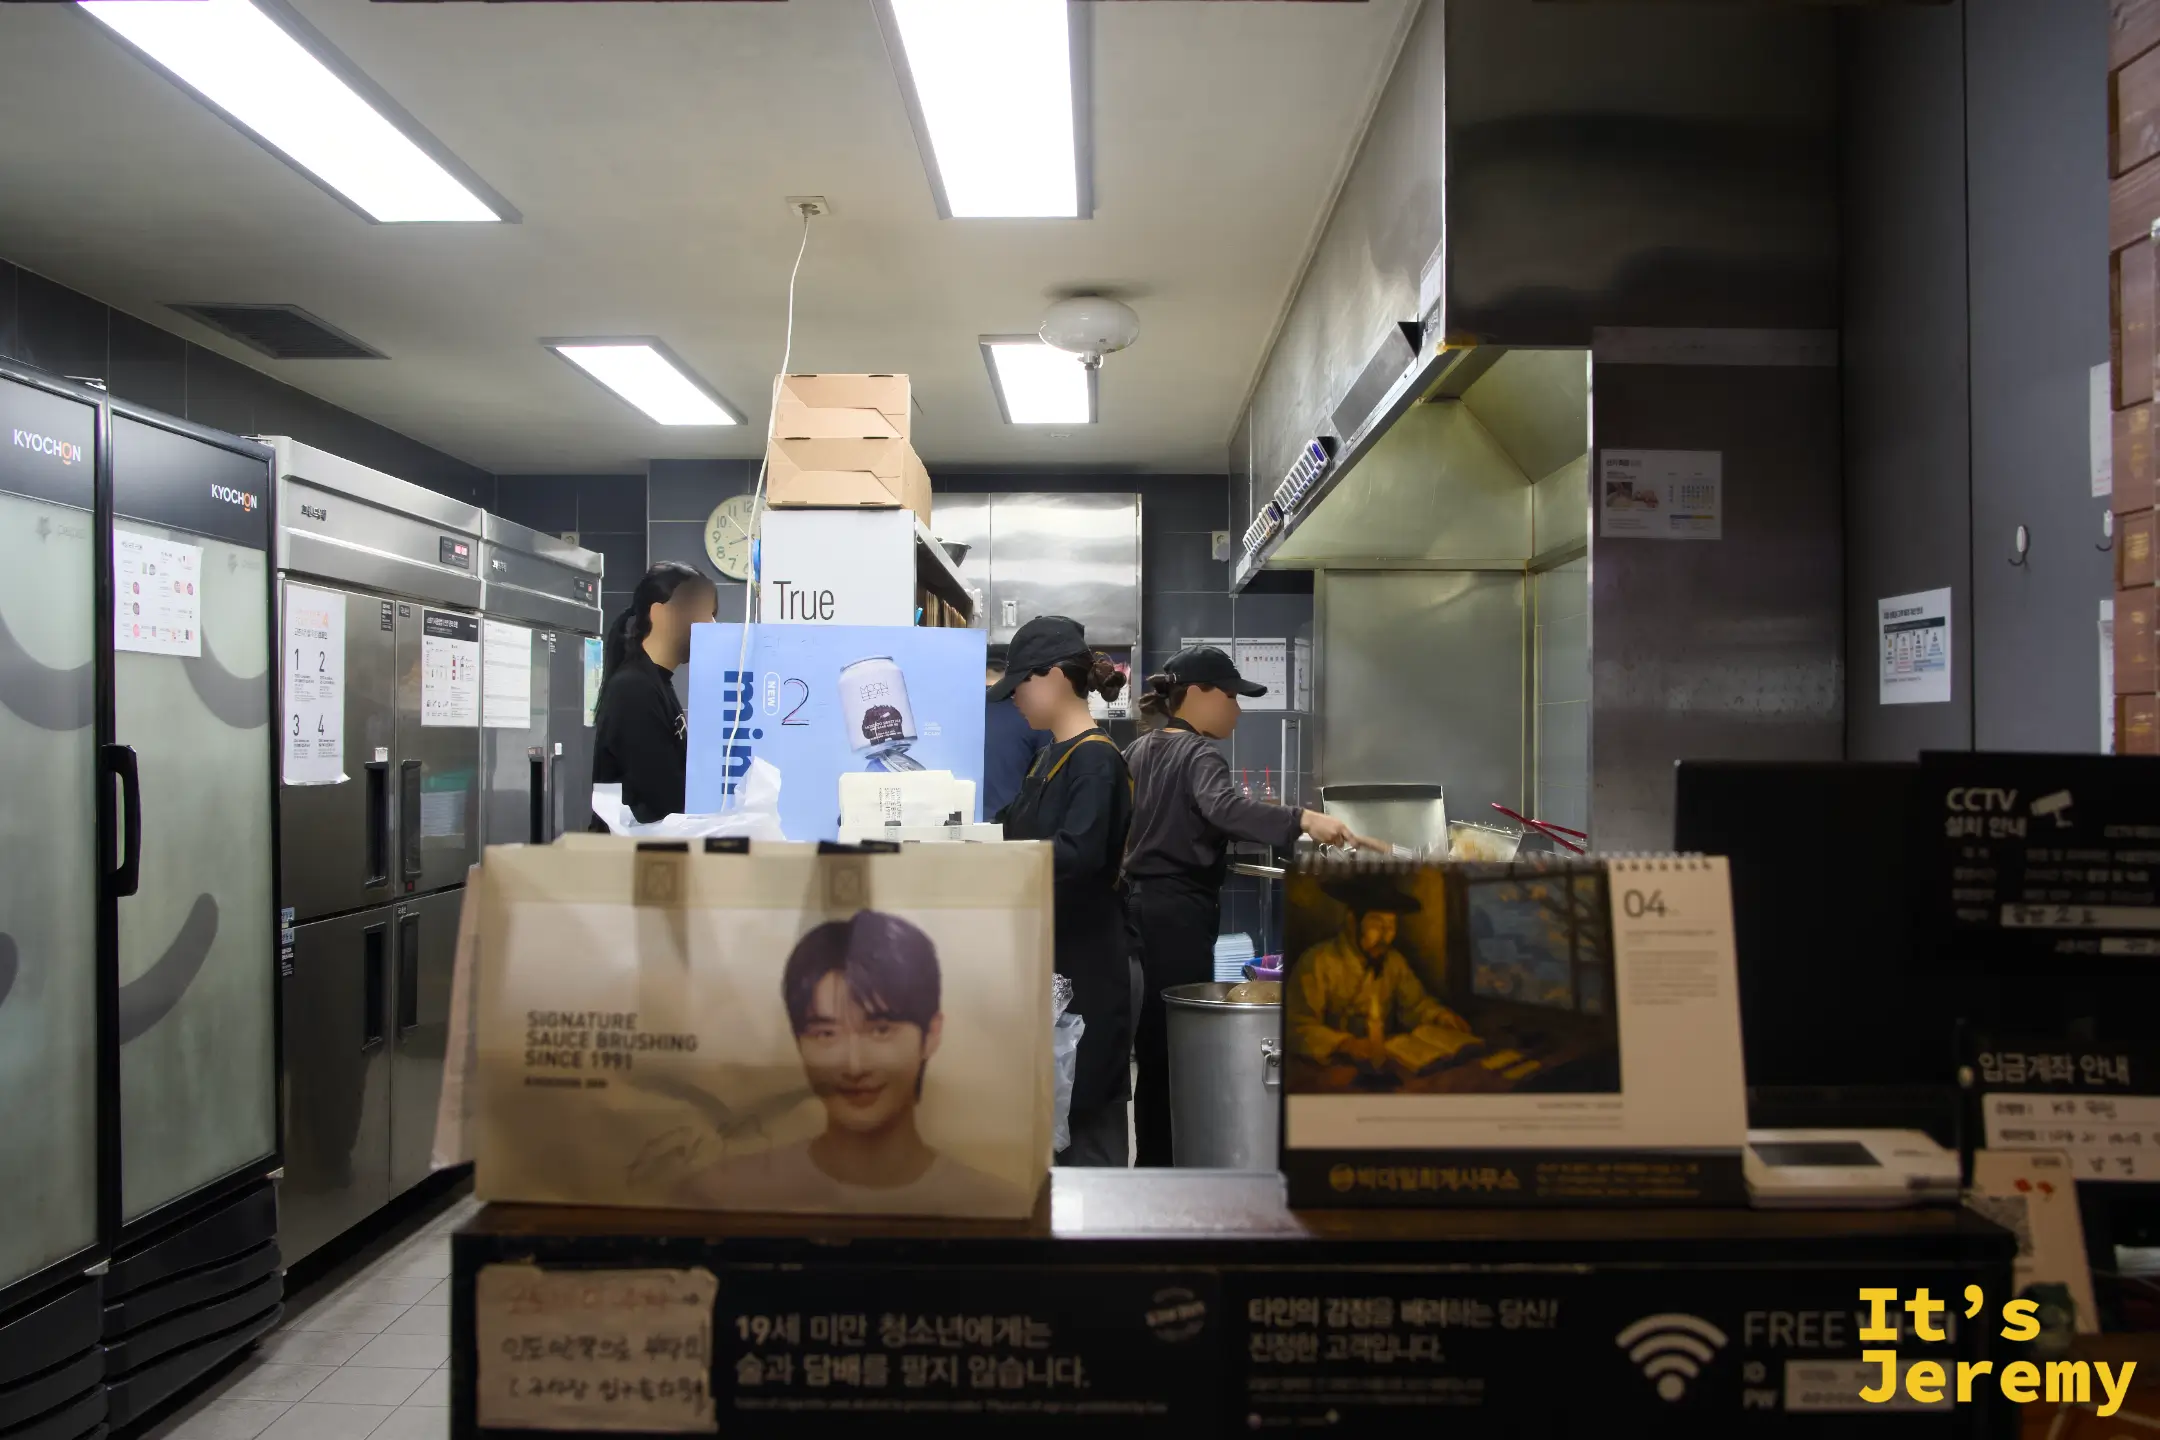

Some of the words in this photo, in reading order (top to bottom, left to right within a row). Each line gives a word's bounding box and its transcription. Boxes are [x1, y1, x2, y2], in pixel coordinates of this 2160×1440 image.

[13, 429, 82, 463] KYOCHON
[211, 484, 258, 510] KYOCHON
[716, 515, 727, 528] 10
[728, 505, 737, 517] 11
[712, 530, 722, 543] 9
[716, 546, 726, 559] 8
[728, 557, 737, 570] 7
[773, 580, 835, 621] True
[294, 648, 300, 671] 1
[318, 650, 325, 673] 2
[767, 680, 776, 708] NEW
[293, 713, 300, 736] 3
[317, 714, 325, 736] 4
[1945, 786, 2020, 812] CCTV
[1623, 888, 1665, 918] 04
[526, 1011, 637, 1030] SIGNATURE
[525, 1030, 590, 1049] SAUCE
[596, 1031, 699, 1052] BRUSHING
[525, 1050, 583, 1069] SINCE
[591, 1051, 633, 1071] 1991
[1978, 1051, 2076, 1085] 입금계좌
[2079, 1053, 2131, 1086] 안내
[1247, 1295, 1320, 1328] 타인의
[735, 1313, 801, 1345] 19세
[809, 1312, 867, 1346] 미만
[878, 1313, 1054, 1350] 청소년에게는
[1742, 1309, 1848, 1349] FREE
[1248, 1331, 1320, 1364] 진정한
[735, 1353, 795, 1387] 술과
[802, 1352, 890, 1388] 담배를
[900, 1353, 960, 1388] 팔지
